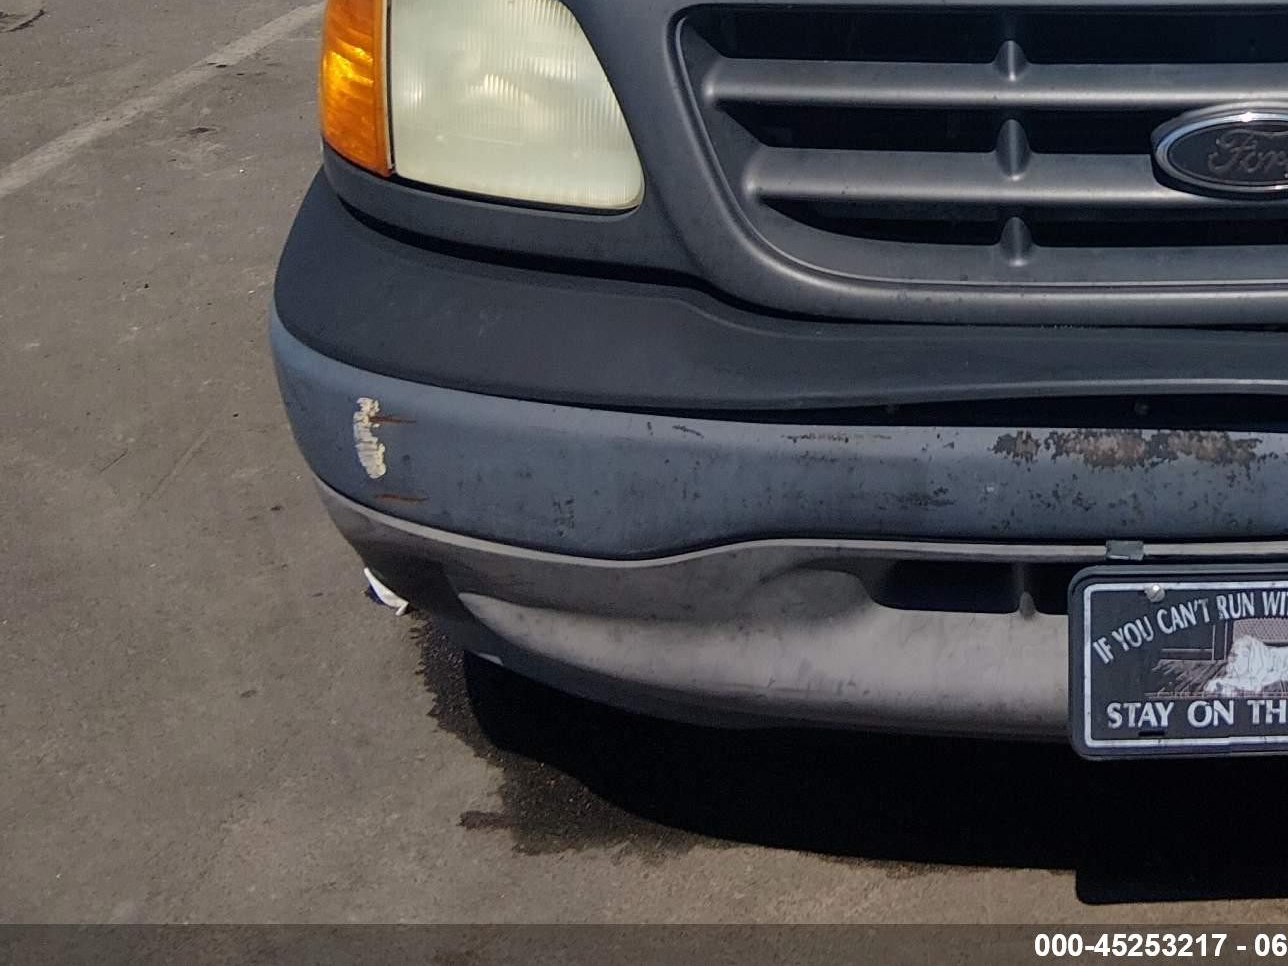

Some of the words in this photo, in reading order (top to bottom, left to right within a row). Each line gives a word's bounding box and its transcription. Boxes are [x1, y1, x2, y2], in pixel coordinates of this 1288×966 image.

[1093, 637, 1113, 664] IF
[1111, 616, 1154, 653] YOU
[1156, 597, 1210, 635] CAN'T
[1216, 591, 1255, 620] RUN
[1106, 700, 1175, 729] STAY
[1187, 699, 1235, 726] ON
